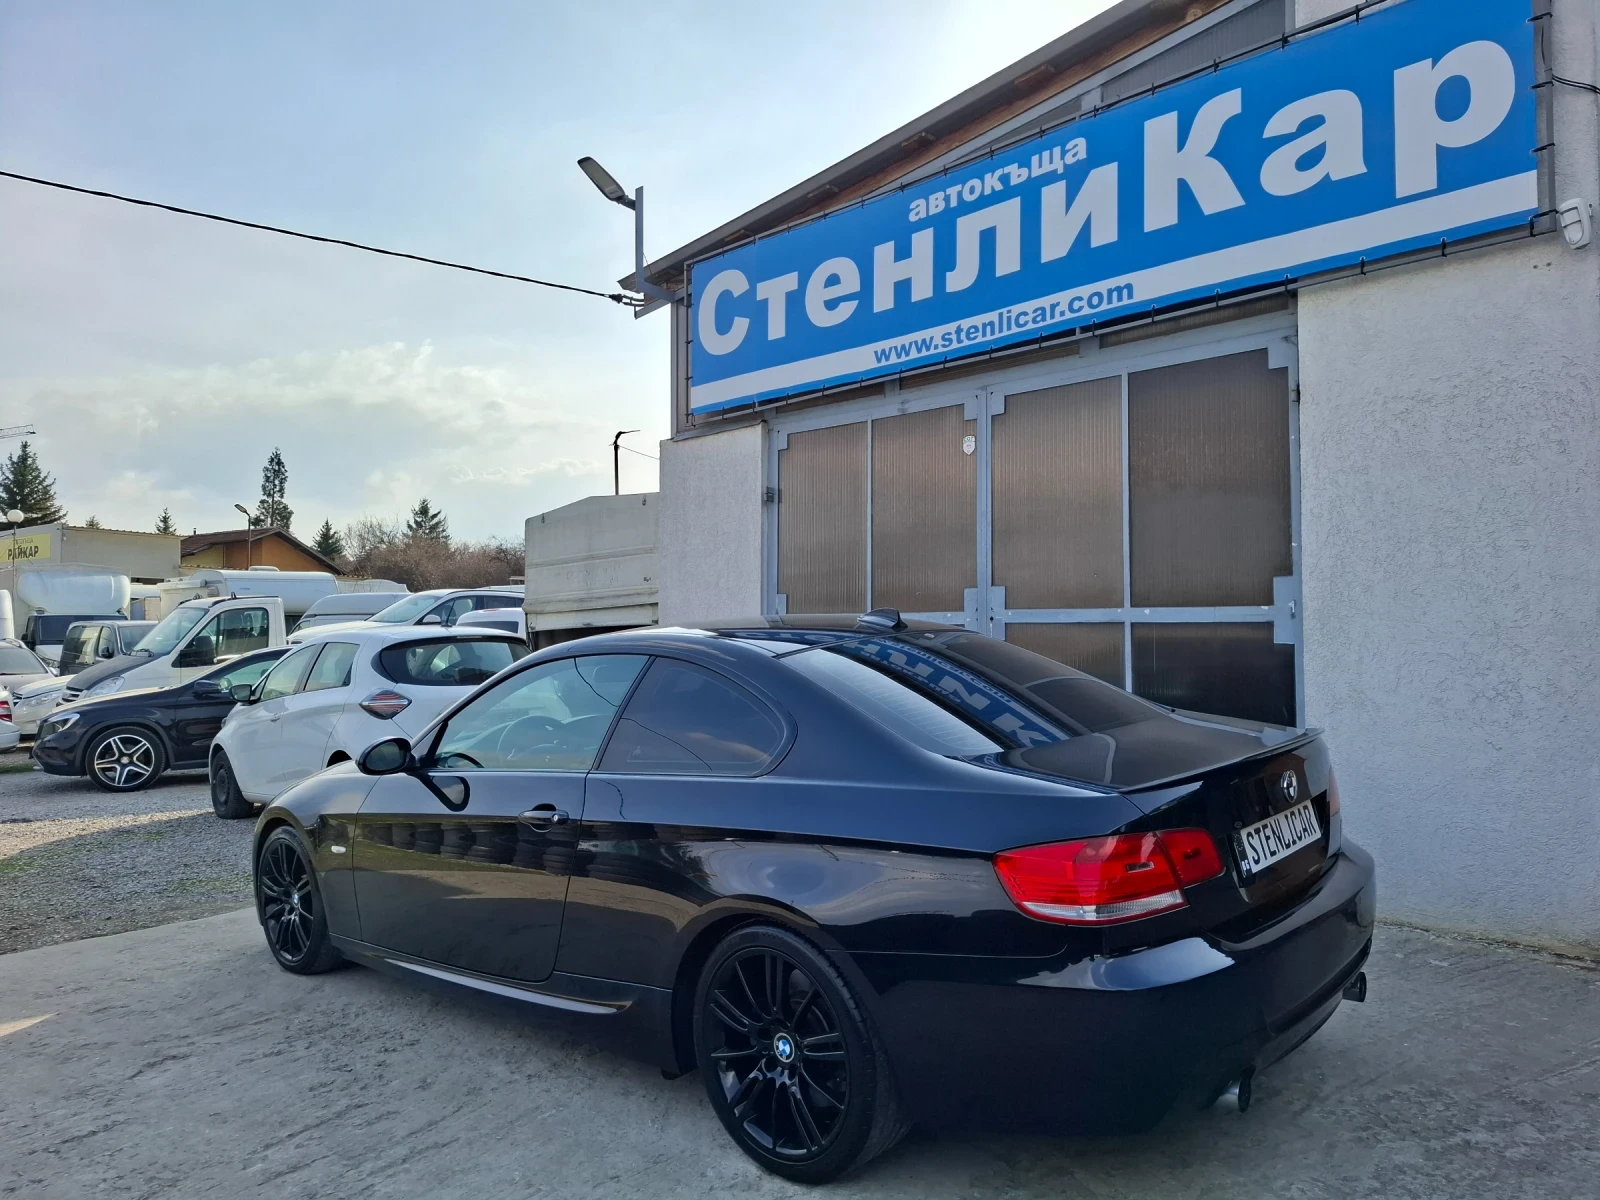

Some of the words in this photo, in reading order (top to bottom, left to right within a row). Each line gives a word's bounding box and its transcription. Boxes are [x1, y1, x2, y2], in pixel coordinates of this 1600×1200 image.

[697, 40, 1516, 356] СтенлиКар
[907, 137, 1087, 223] автокъща
[874, 281, 1134, 363] www.stenlicar.com
[1246, 804, 1316, 865] STENLICAR
